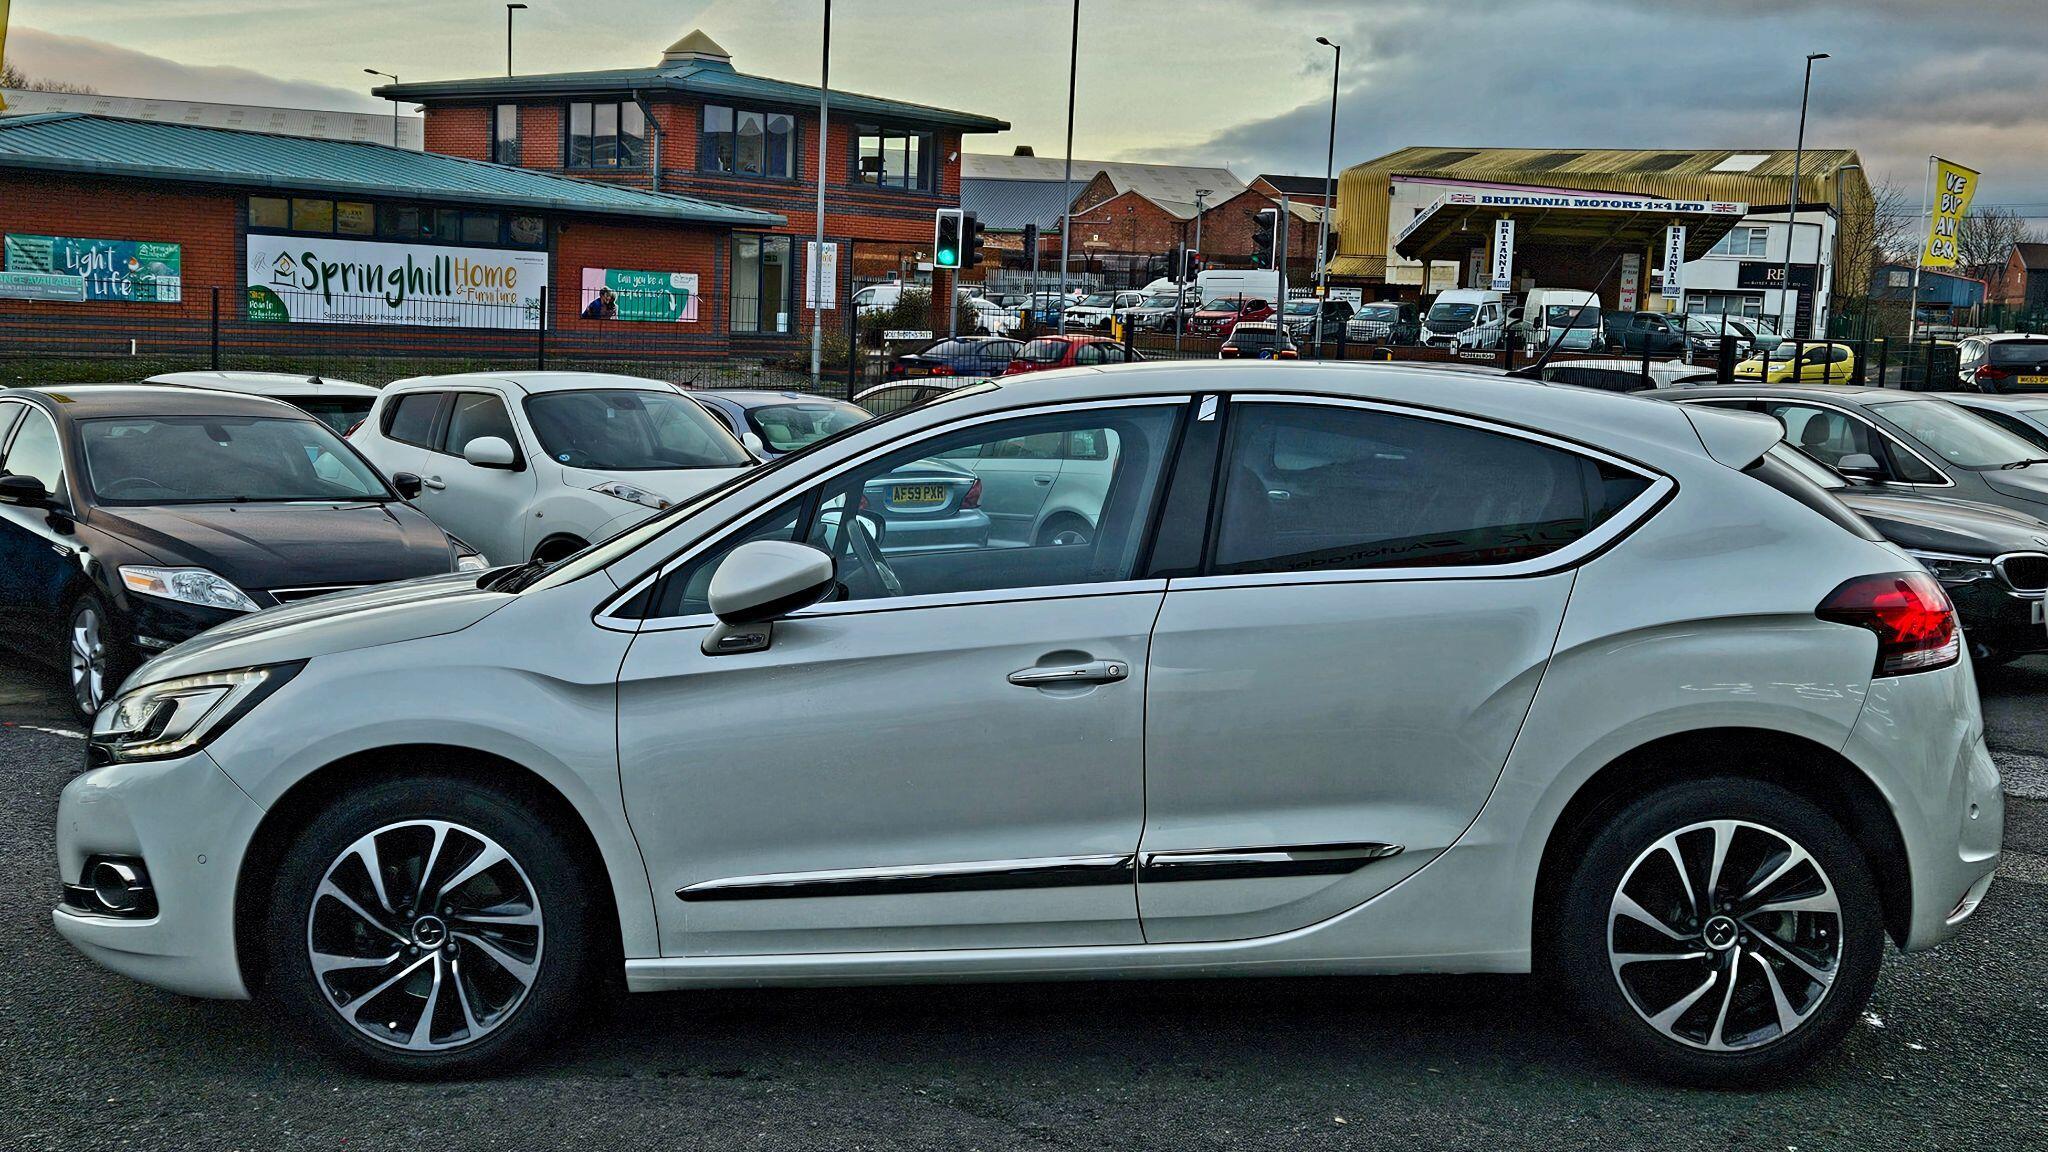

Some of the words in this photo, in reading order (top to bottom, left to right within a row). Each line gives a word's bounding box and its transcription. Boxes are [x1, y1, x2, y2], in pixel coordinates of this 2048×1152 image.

[1945, 171, 1967, 194] WE
[1481, 195, 1570, 207] BRITANNIA
[1574, 199, 1642, 209] MOTORS
[1675, 203, 1704, 211] LTD
[1935, 216, 1956, 237] AN
[1498, 221, 1509, 279] BRITANNIA
[1668, 227, 1680, 285] BRITANNIA
[66, 246, 115, 277] Light
[301, 251, 451, 308] Springhill
[454, 257, 517, 288] Home
[618, 273, 631, 283] Can
[633, 275, 646, 287] you
[648, 274, 656, 285] be
[1767, 268, 1785, 280] RB
[28, 277, 82, 288] AVAILABLE
[93, 271, 132, 295] Life
[1493, 280, 1510, 288] MOTORS
[467, 287, 516, 303] Furniture
[324, 312, 349, 320] Support
[894, 486, 920, 500] AF59
[923, 485, 944, 500] PXR
